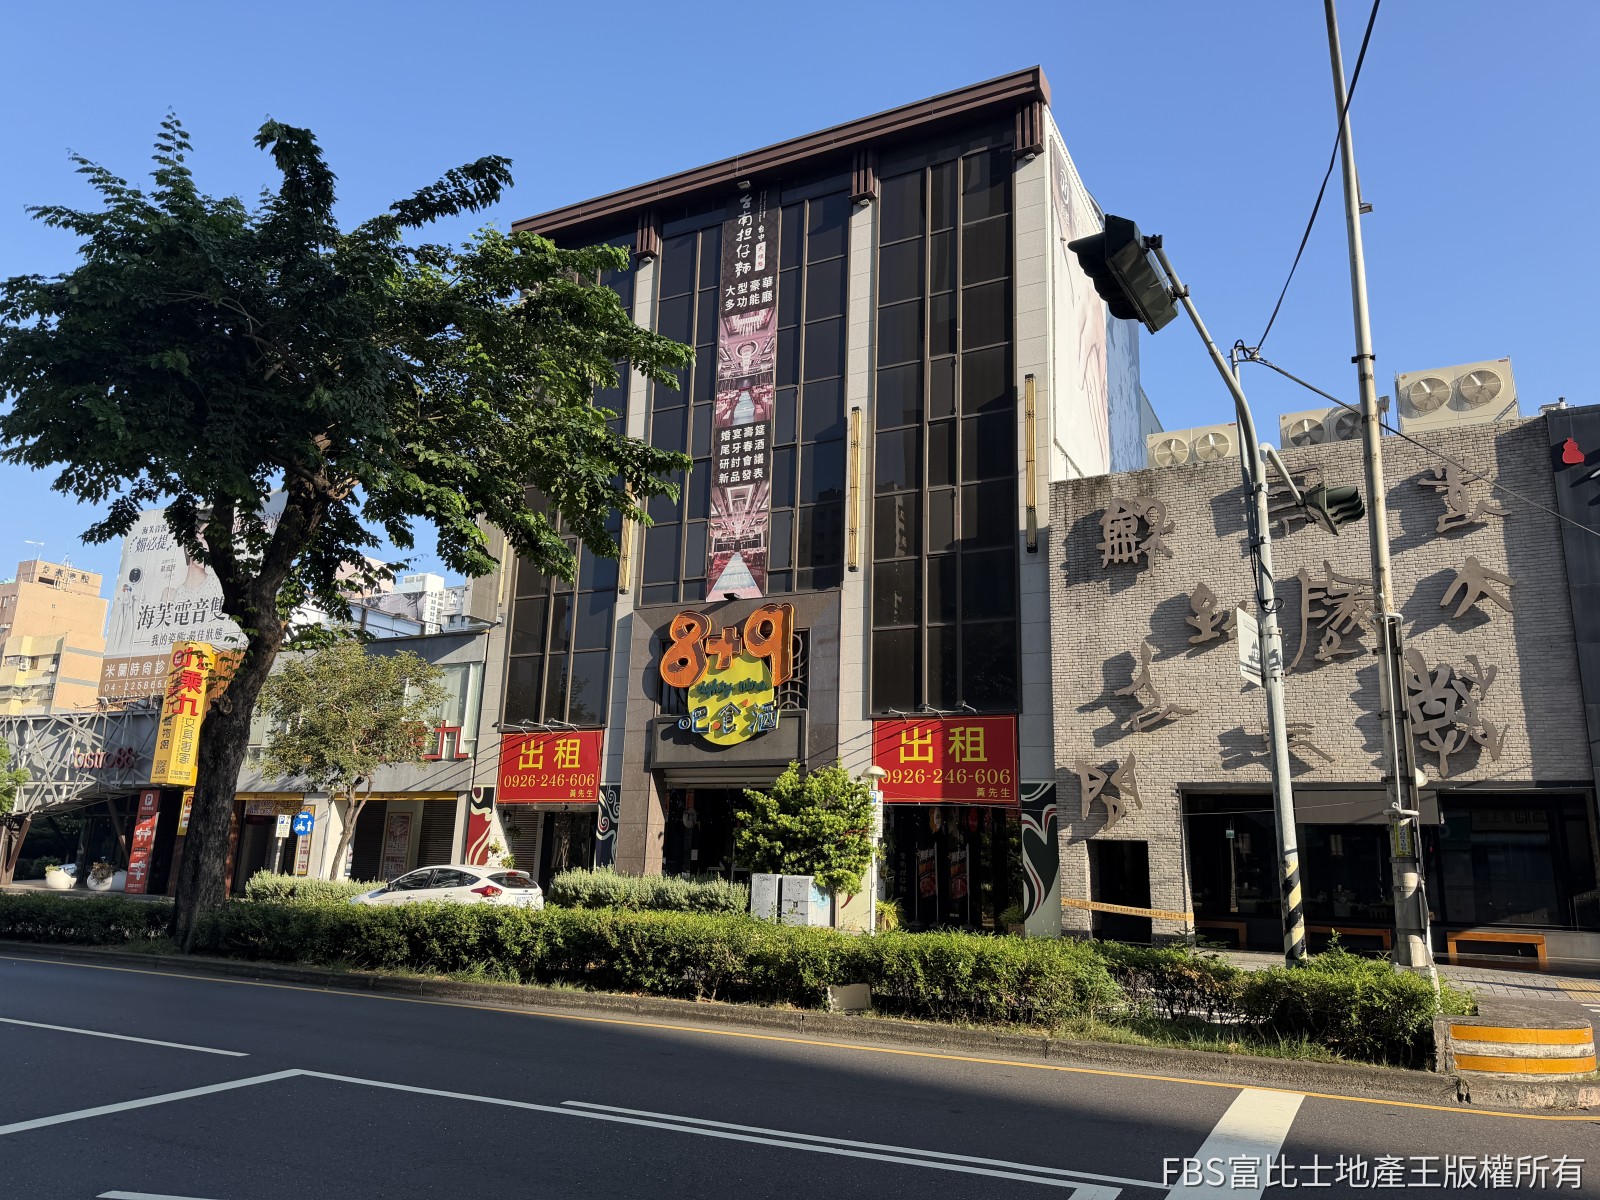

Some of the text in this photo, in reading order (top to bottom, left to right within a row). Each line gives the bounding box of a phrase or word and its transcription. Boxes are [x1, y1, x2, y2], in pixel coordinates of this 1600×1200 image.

[725, 276, 774, 298] 大型豪華
[725, 290, 773, 311] 多功能廳
[720, 424, 766, 441] 婚宴壽筵
[720, 439, 765, 456] 尾牙春酒
[719, 453, 764, 470] 研討會議
[718, 467, 764, 484] 新品發表
[137, 596, 231, 630] 海芙電音雙
[900, 726, 988, 763] 出租
[518, 738, 581, 770] 出租
[504, 773, 595, 788] 0926-246-606
[881, 768, 1011, 784] 0926-246-606
[569, 789, 593, 798] 黃先生
[976, 787, 1011, 798] 黃先生
